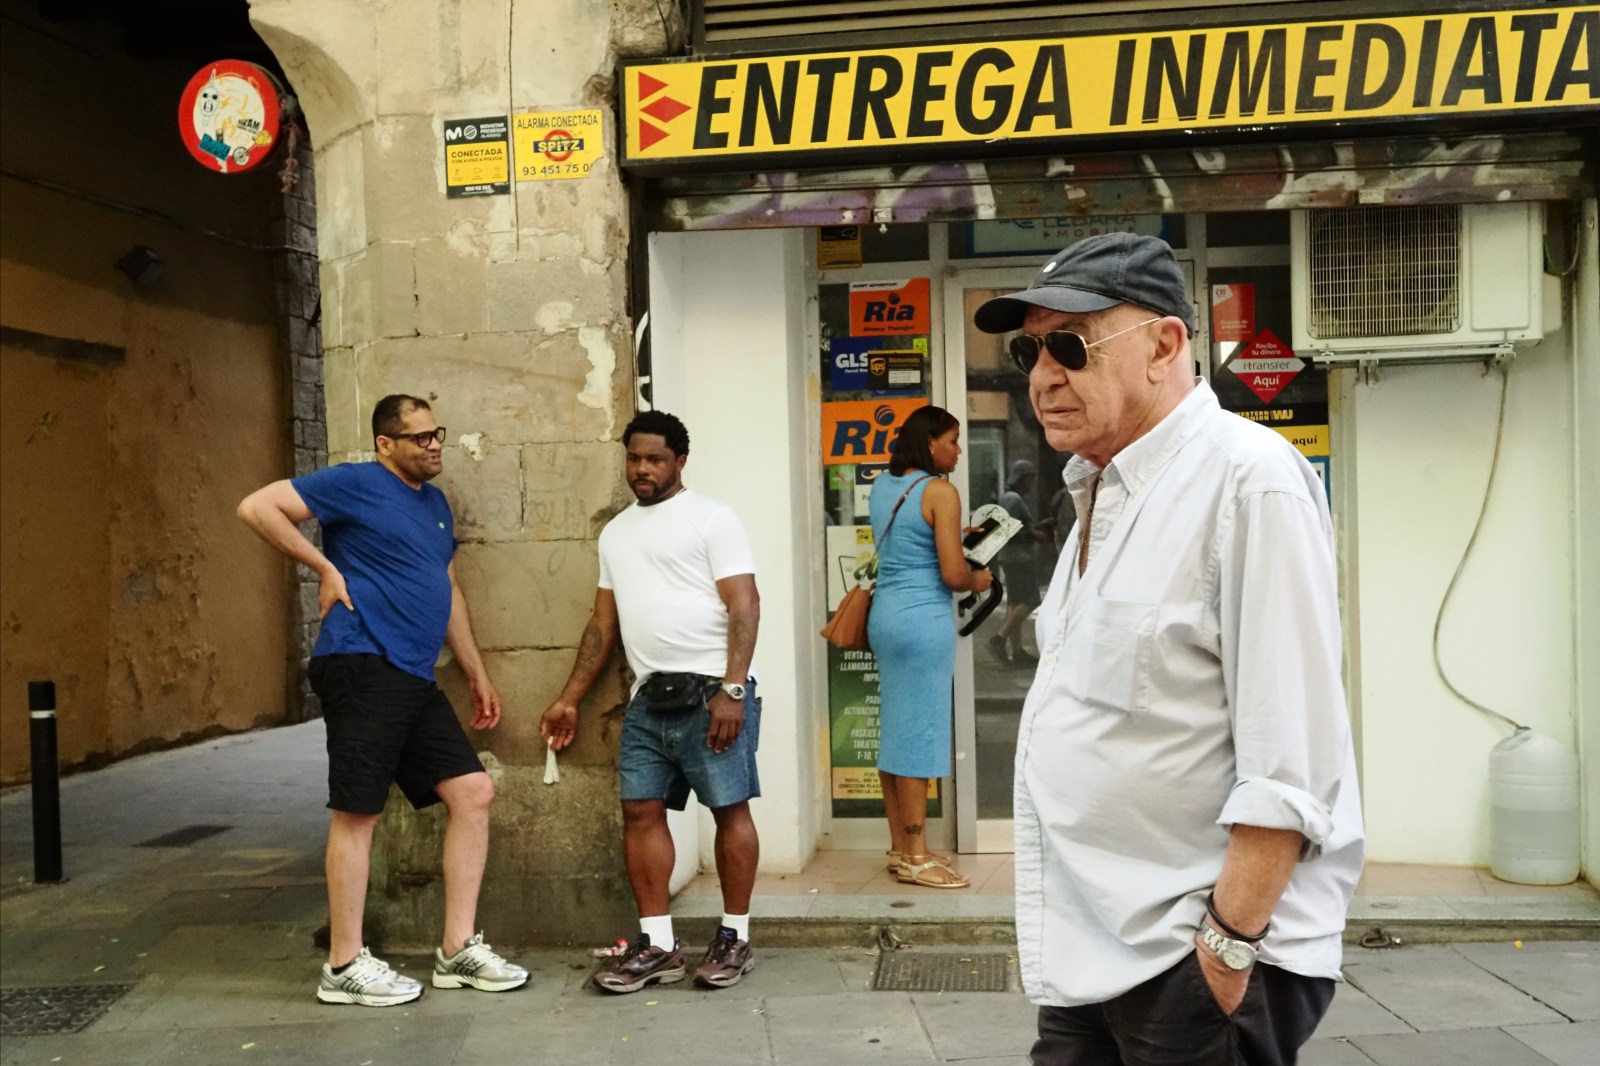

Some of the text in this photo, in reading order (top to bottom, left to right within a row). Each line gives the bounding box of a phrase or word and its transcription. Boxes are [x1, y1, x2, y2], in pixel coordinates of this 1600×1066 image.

[692, 10, 1600, 150] ENTREGA INMEDIATA
[517, 114, 598, 129] ALARMA CONECTADA
[451, 148, 503, 158] CONECTADA
[522, 163, 591, 176] 93 451 75 0
[864, 292, 915, 323] Ria
[835, 352, 868, 369] GLS
[1253, 374, 1280, 388] Aquí
[1292, 435, 1318, 446] aquí
[844, 651, 863, 660] VENTA
[840, 662, 872, 671] LLAMADAS
[863, 673, 880, 682] IMPR
[867, 717, 875, 727] DE
[851, 728, 877, 738] PASAJES
